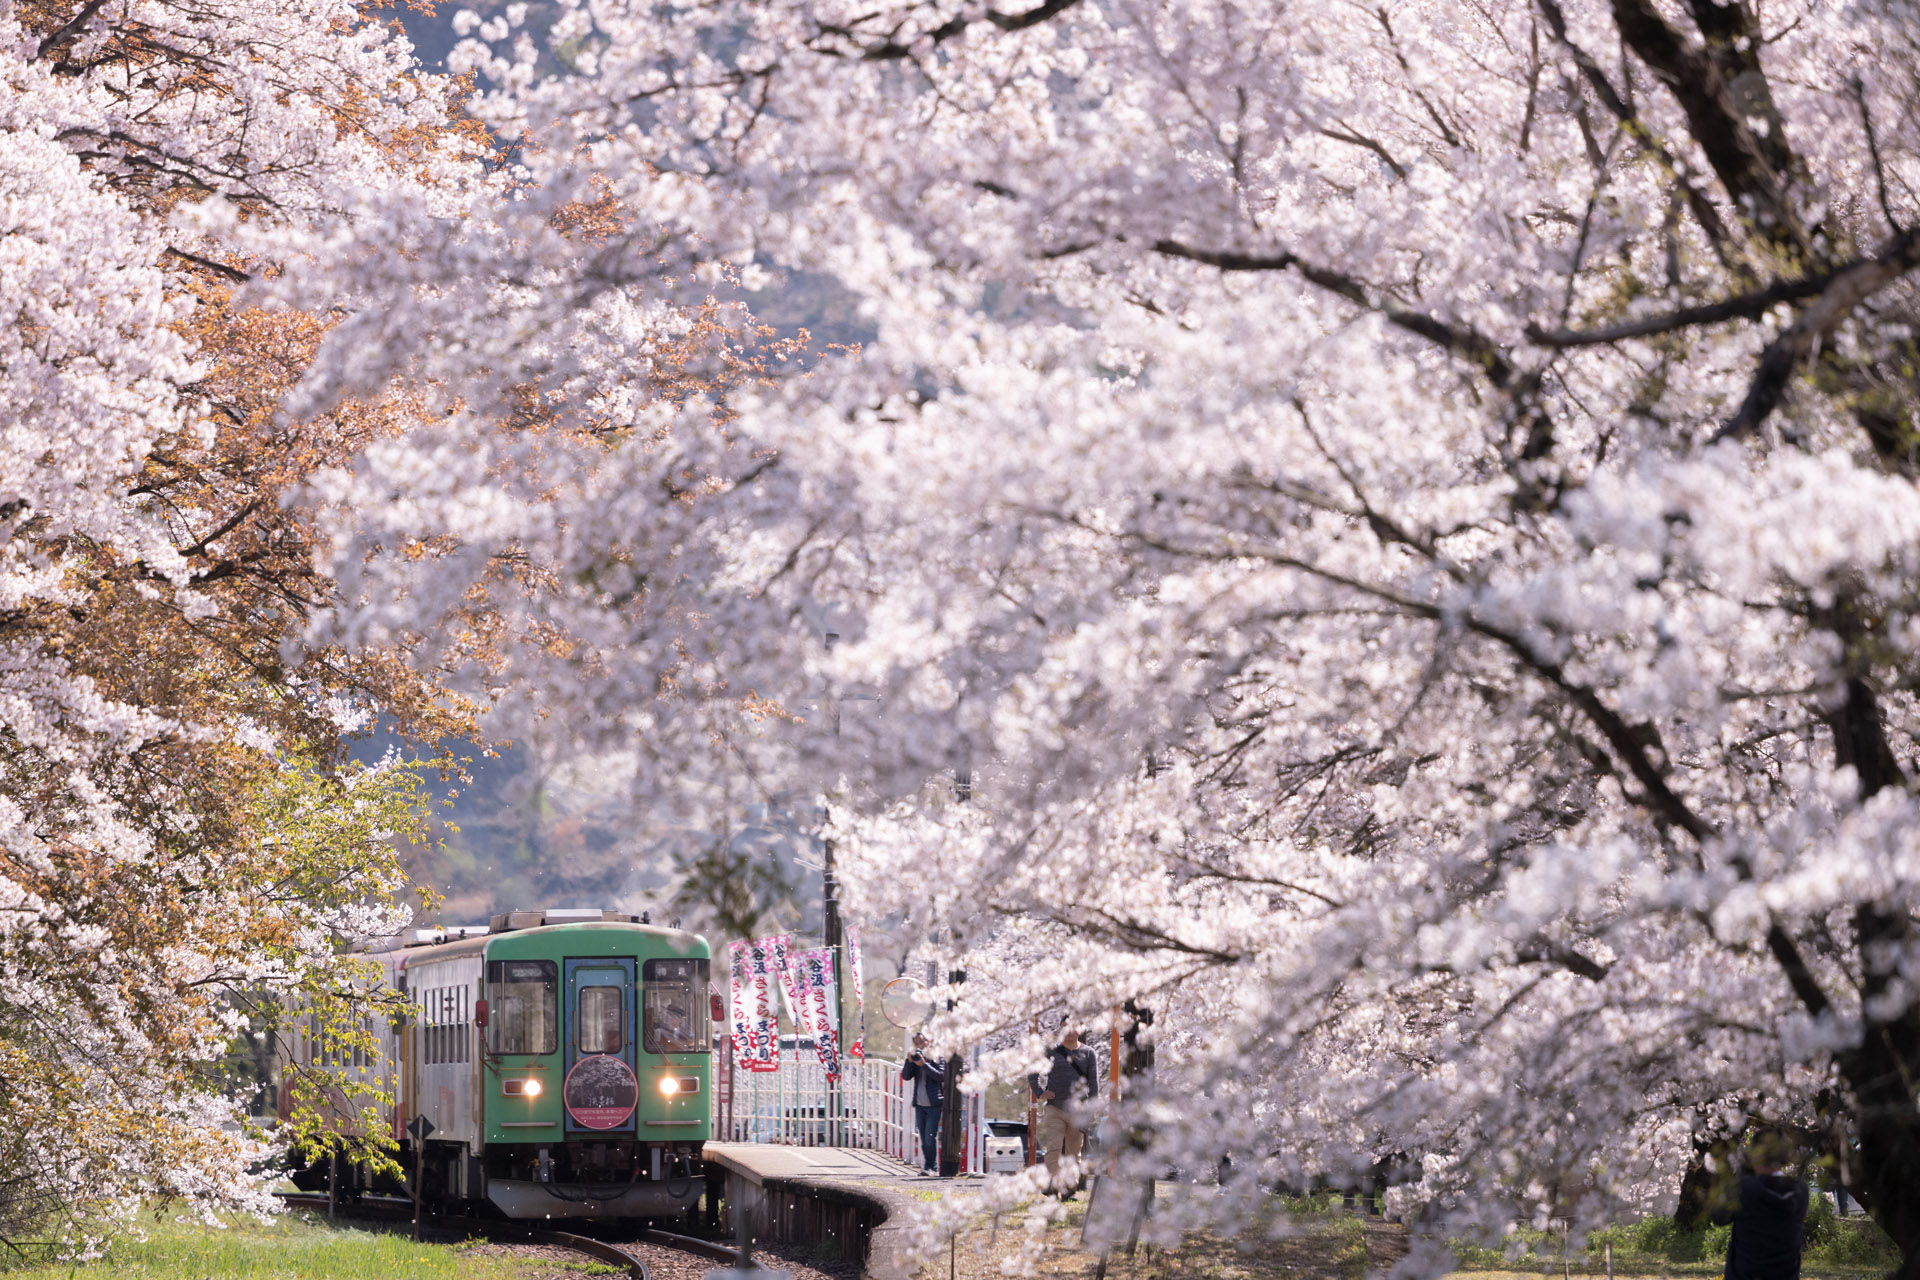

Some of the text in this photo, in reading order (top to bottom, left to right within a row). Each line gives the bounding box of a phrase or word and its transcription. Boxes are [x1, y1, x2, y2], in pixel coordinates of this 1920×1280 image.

[751, 947, 770, 1061] 谷汲さくらまつり
[808, 958, 839, 1074] 谷汲さくらまつり
